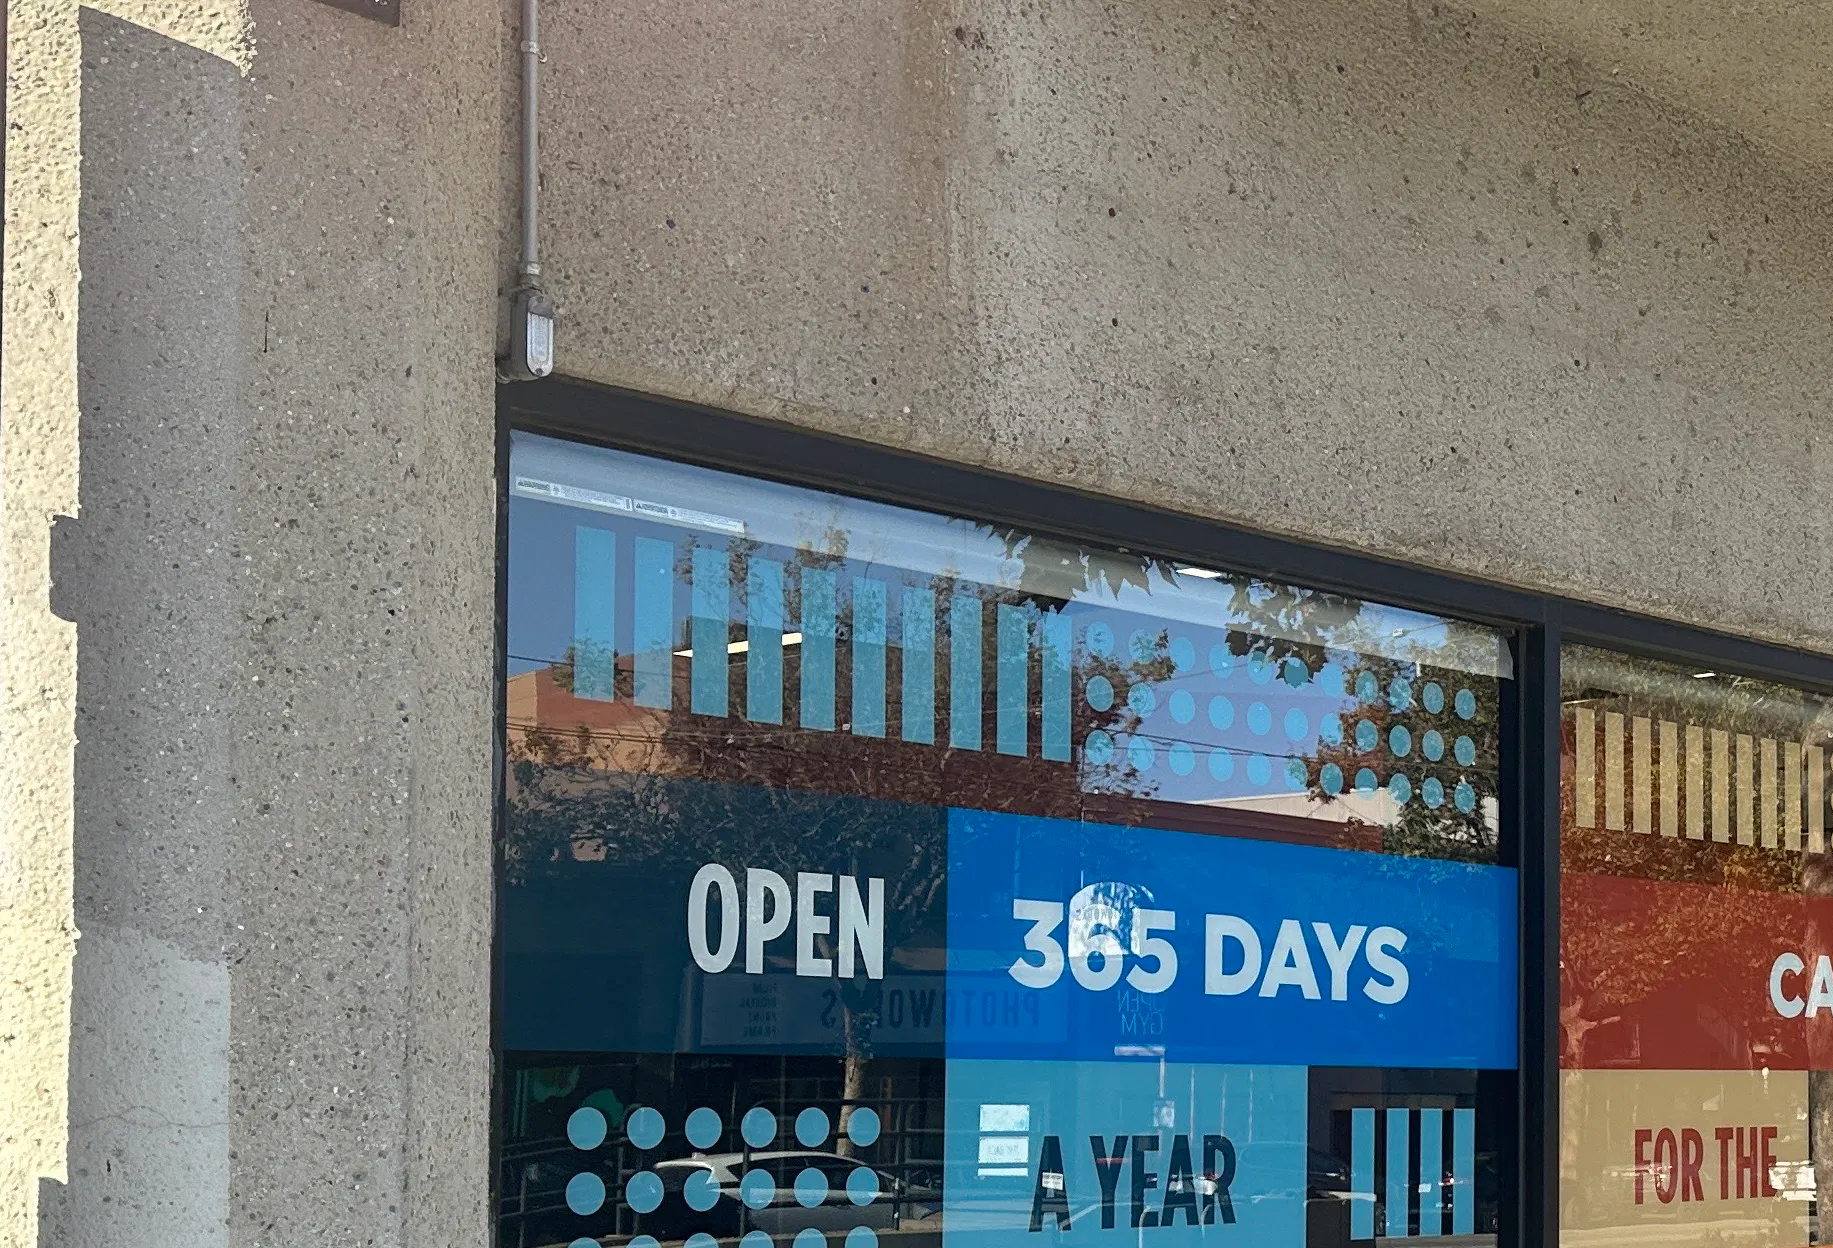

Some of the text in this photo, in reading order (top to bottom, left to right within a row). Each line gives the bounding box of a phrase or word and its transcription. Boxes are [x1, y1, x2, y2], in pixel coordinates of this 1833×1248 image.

[686, 862, 1411, 1005] OPEN 365 DAYS
[1028, 1133, 1238, 1234] A YEAR
[1633, 1124, 1779, 1206] FOR THE
